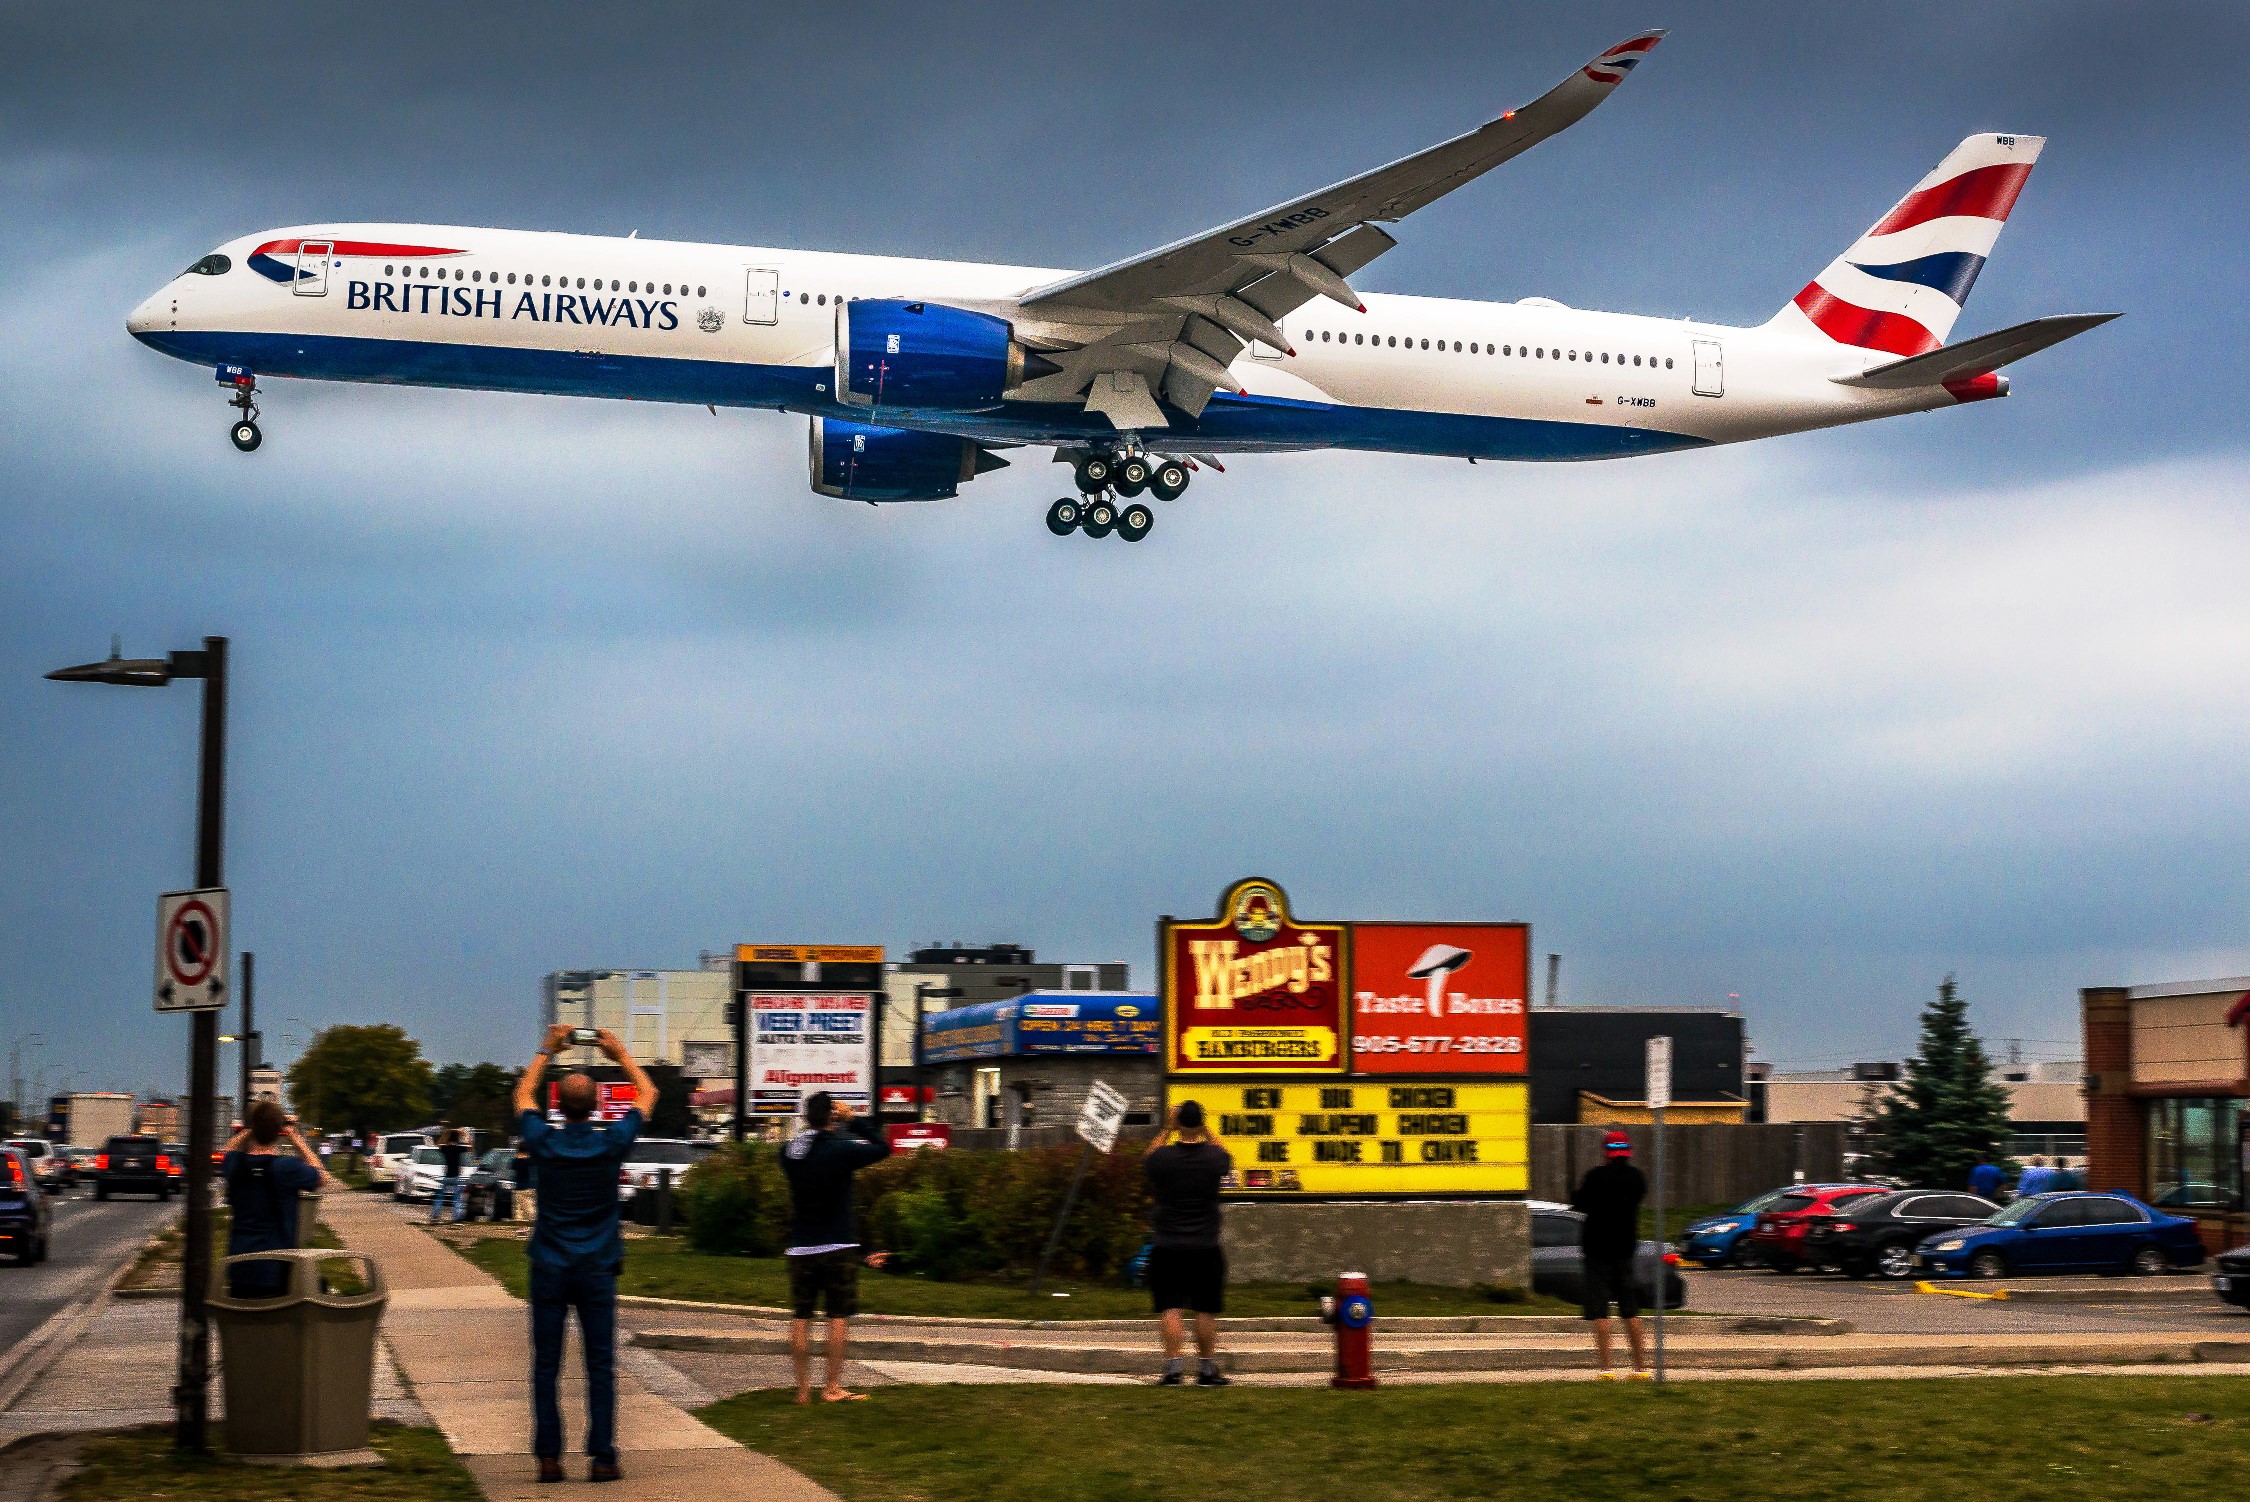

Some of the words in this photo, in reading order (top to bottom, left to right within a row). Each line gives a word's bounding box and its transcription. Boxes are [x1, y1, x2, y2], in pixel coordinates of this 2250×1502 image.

[1996, 135, 2015, 146] WBB
[1227, 207, 1331, 248] G-XWBB
[346, 281, 502, 319] BRITISH
[512, 291, 679, 331] AIRWAYS
[226, 365, 243, 375] WBB
[1617, 396, 1656, 408] G-XWBB
[1354, 991, 1425, 1014] Taste
[1446, 992, 1524, 1014] Boxes
[1019, 1020, 1060, 1032] OPEN
[757, 1034, 798, 1044] AUTO
[801, 1034, 864, 1044] REPAIRS
[1196, 1040, 1321, 1058] HAMBURGERS
[763, 1069, 858, 1087] Alignment
[1243, 1087, 1282, 1109] NEW
[1388, 1087, 1455, 1109] CHICKEN
[1219, 1114, 1274, 1135] BACON
[1398, 1114, 1469, 1135] CHICKEN
[1256, 1141, 1289, 1162] ARE
[1380, 1141, 1403, 1162] TO
